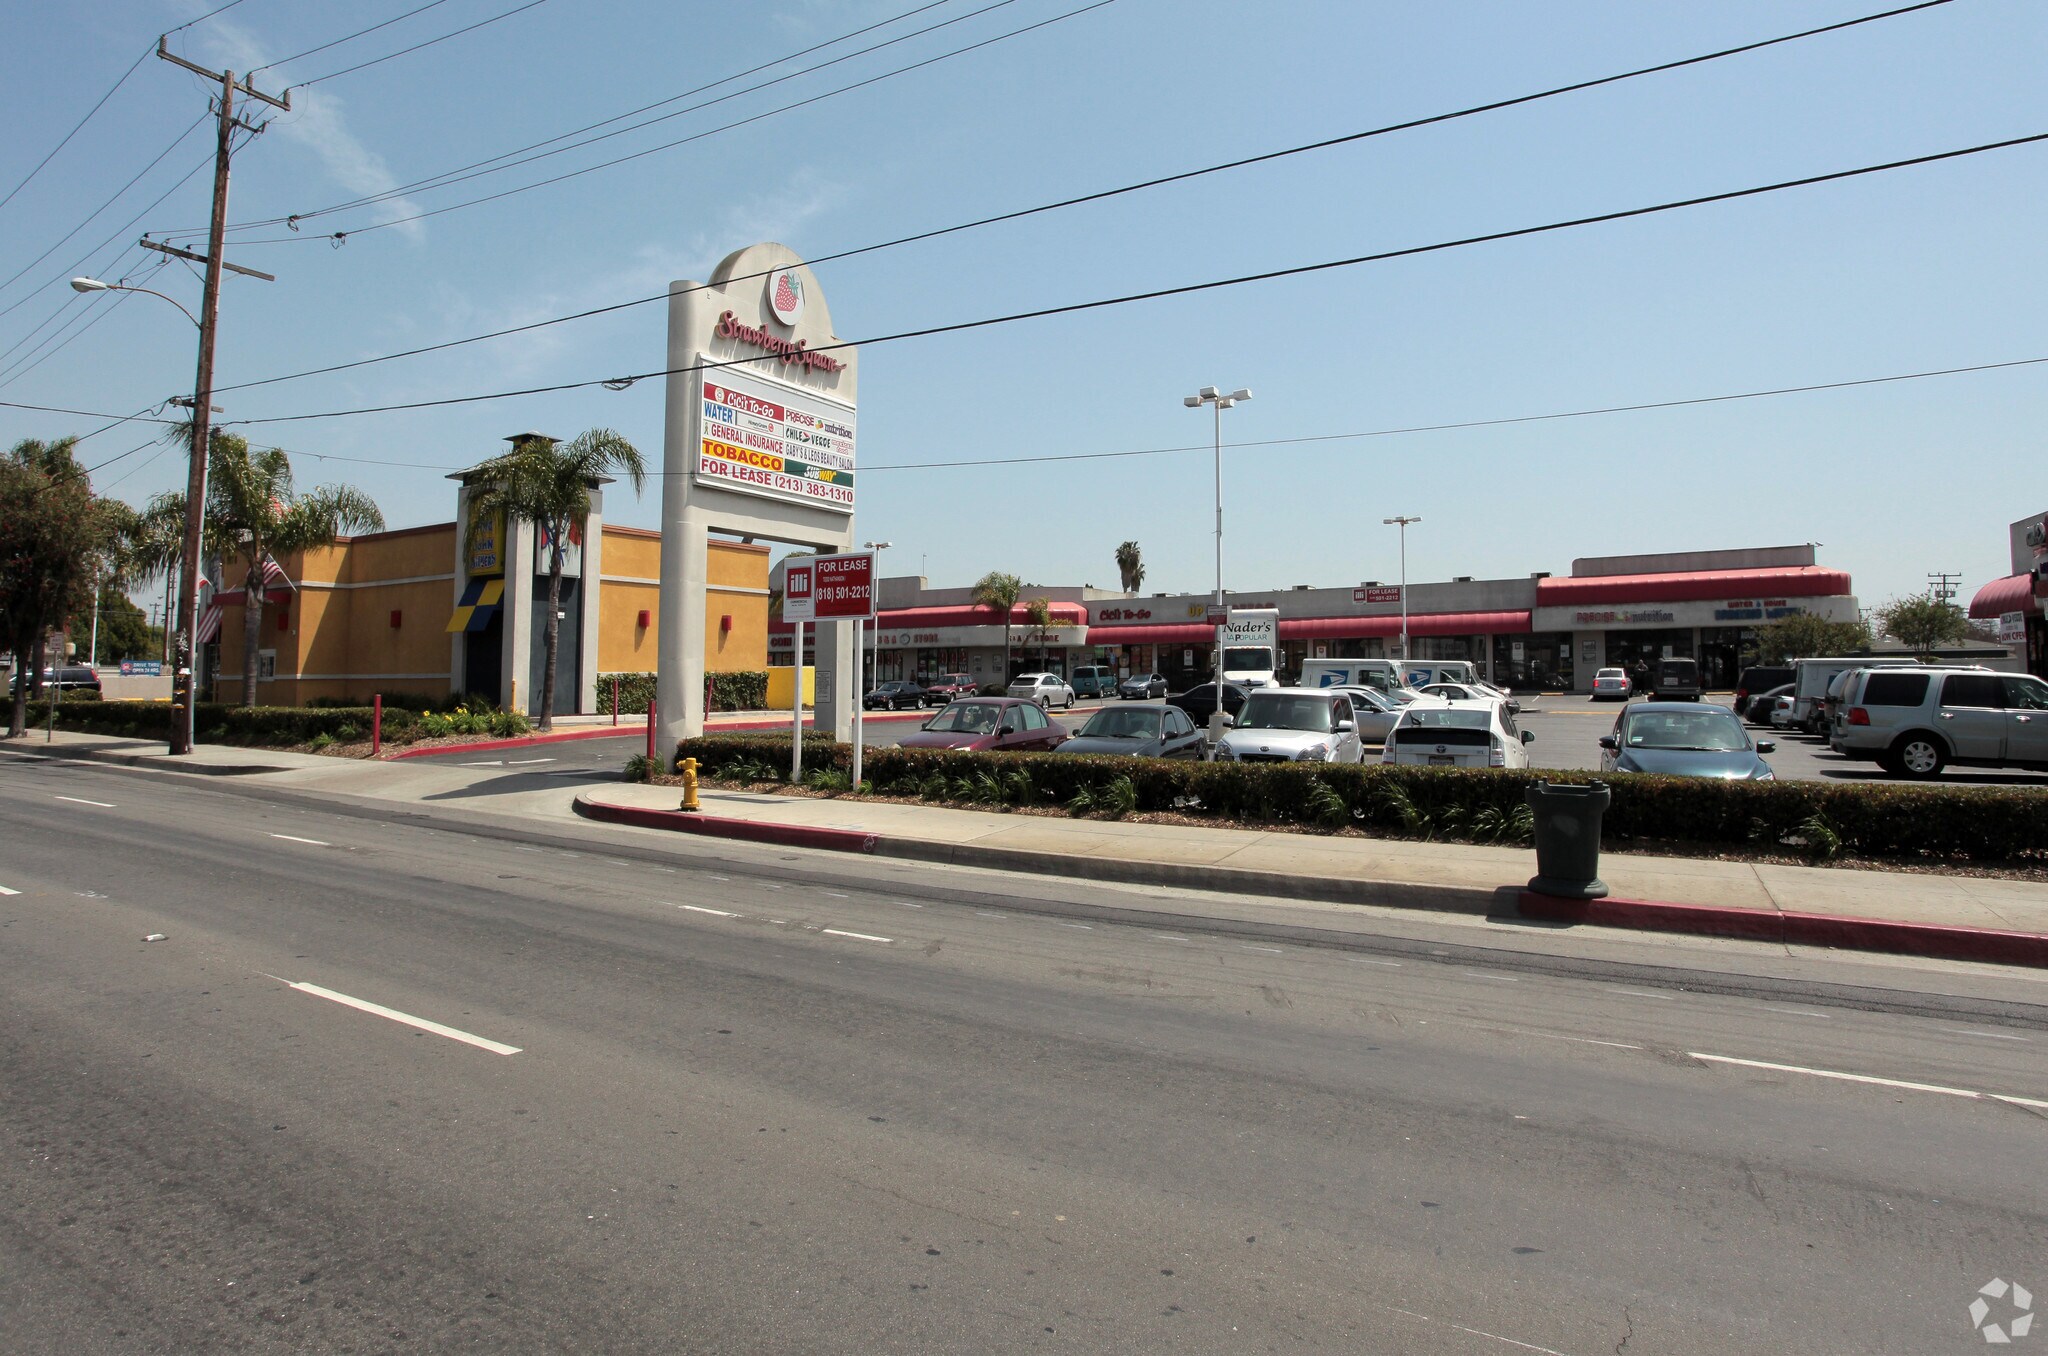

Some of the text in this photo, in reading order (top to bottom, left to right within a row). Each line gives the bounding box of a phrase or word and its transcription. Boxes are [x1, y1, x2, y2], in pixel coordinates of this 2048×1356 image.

[715, 310, 847, 375] Strawberry Square
[704, 401, 733, 424] WATER
[749, 400, 774, 418] To-Go
[785, 410, 853, 439] PRECISE nutrition
[711, 424, 783, 454] GENERAL INSURANCE
[785, 428, 803, 441] CHILE
[702, 440, 782, 470] TOBACCO
[785, 444, 804, 459] GABY'S
[821, 452, 838, 467] BEAUTY
[839, 457, 853, 470] SALON
[701, 458, 853, 502] FOR LEASE (213) 383-1310
[804, 465, 836, 482] SUBWAY
[818, 560, 868, 573] FOR LEASE
[790, 573, 808, 593] illi
[816, 586, 834, 604] (818)
[836, 585, 870, 599] 501-2212
[1727, 599, 1787, 608] WATER HOUSE
[1123, 609, 1151, 620] To-Go
[1223, 621, 1271, 633] Nader's
[1034, 634, 1060, 642] STORE
[1235, 633, 1267, 641] POPULAR
